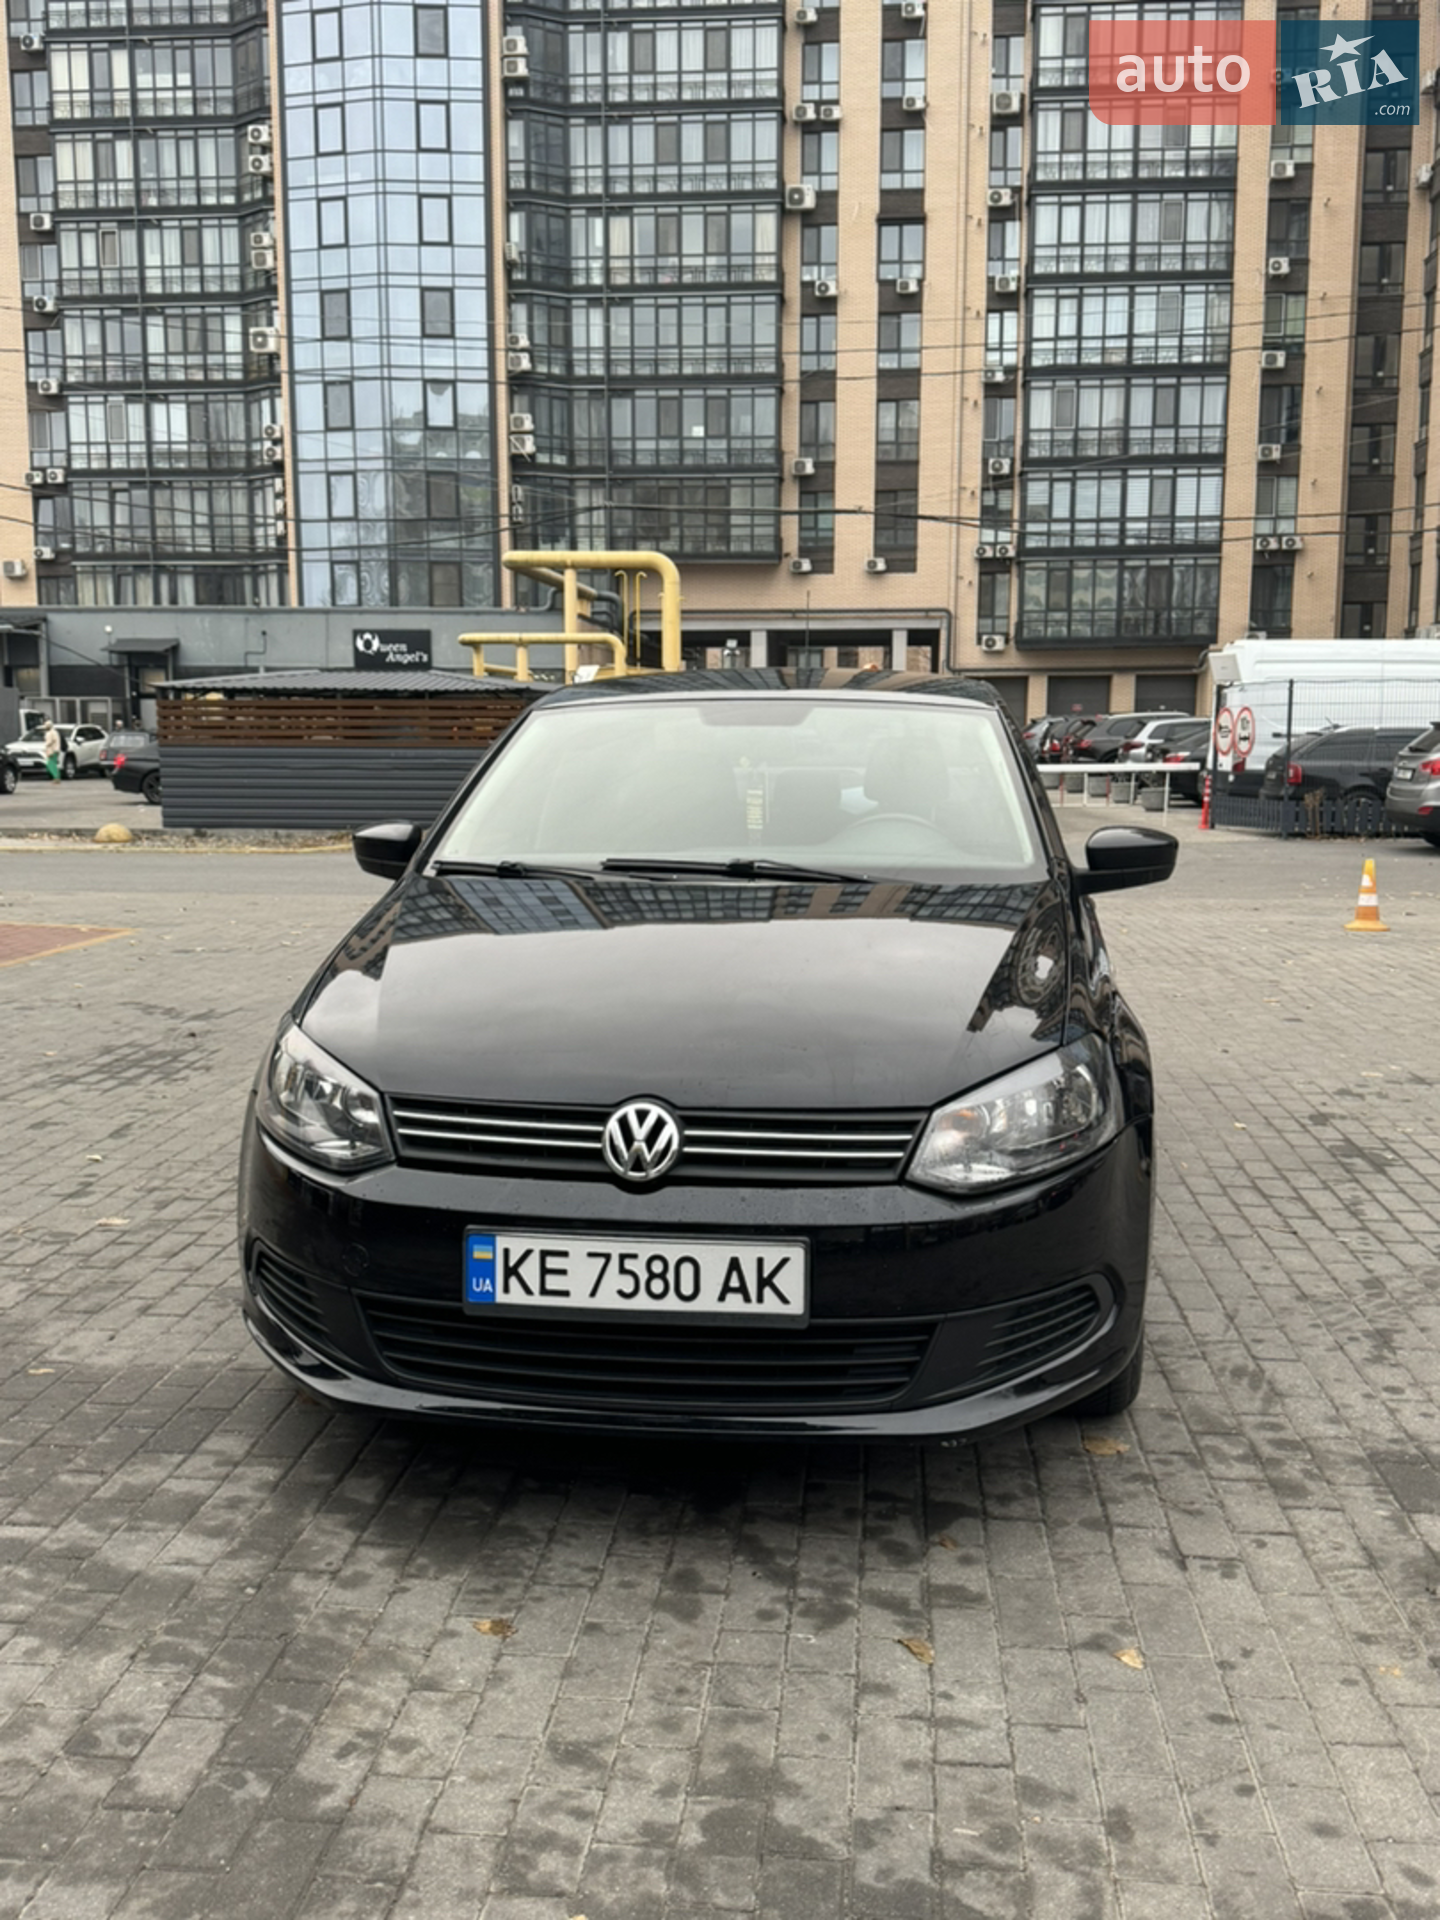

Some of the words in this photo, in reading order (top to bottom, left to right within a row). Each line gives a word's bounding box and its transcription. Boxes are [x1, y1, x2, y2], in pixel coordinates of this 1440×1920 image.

[355, 632, 407, 655] Queen
[604, 1102, 679, 1181] VW
[472, 1277, 493, 1293] UA
[502, 1247, 571, 1298] KE
[586, 1252, 702, 1302] 7580
[717, 1256, 791, 1306] AK
